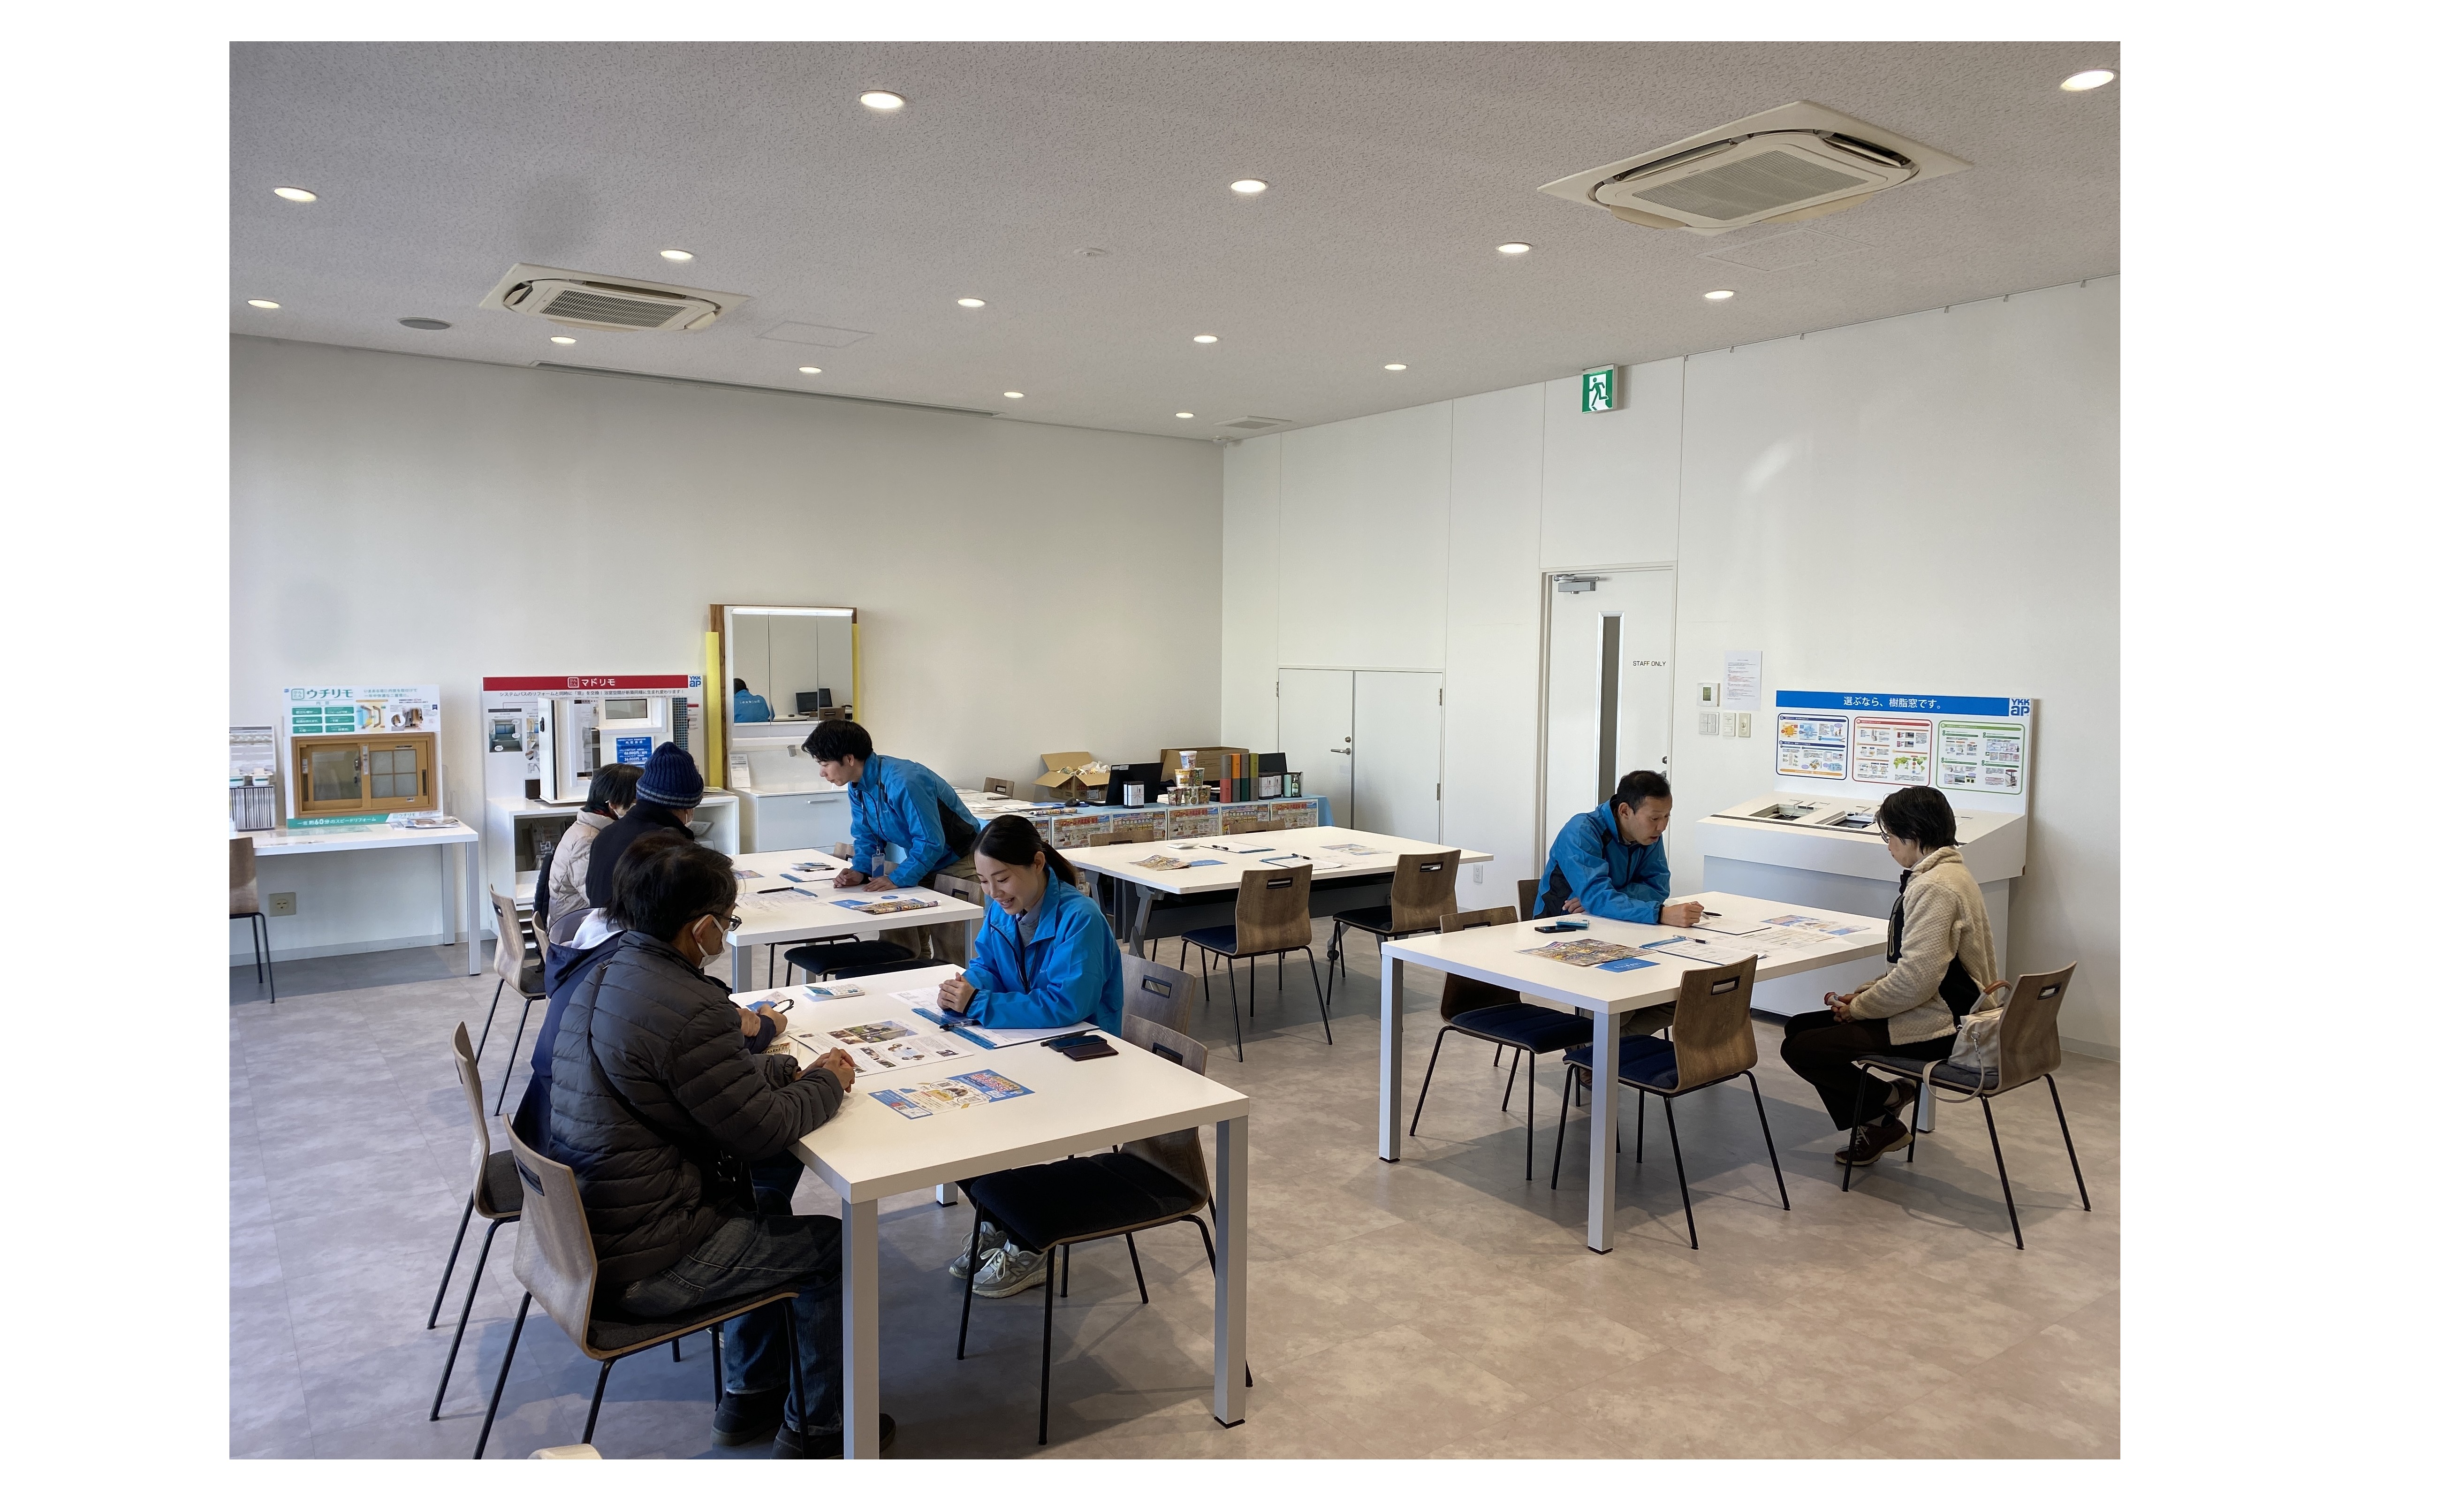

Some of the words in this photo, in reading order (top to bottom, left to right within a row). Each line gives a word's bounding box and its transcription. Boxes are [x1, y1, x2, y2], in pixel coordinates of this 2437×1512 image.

[581, 678, 615, 687] マドリモ
[307, 689, 353, 699] ウチリモ
[1843, 696, 1941, 709] 選ぶなら、樹脂窓です。
[2011, 706, 2030, 716] ap
